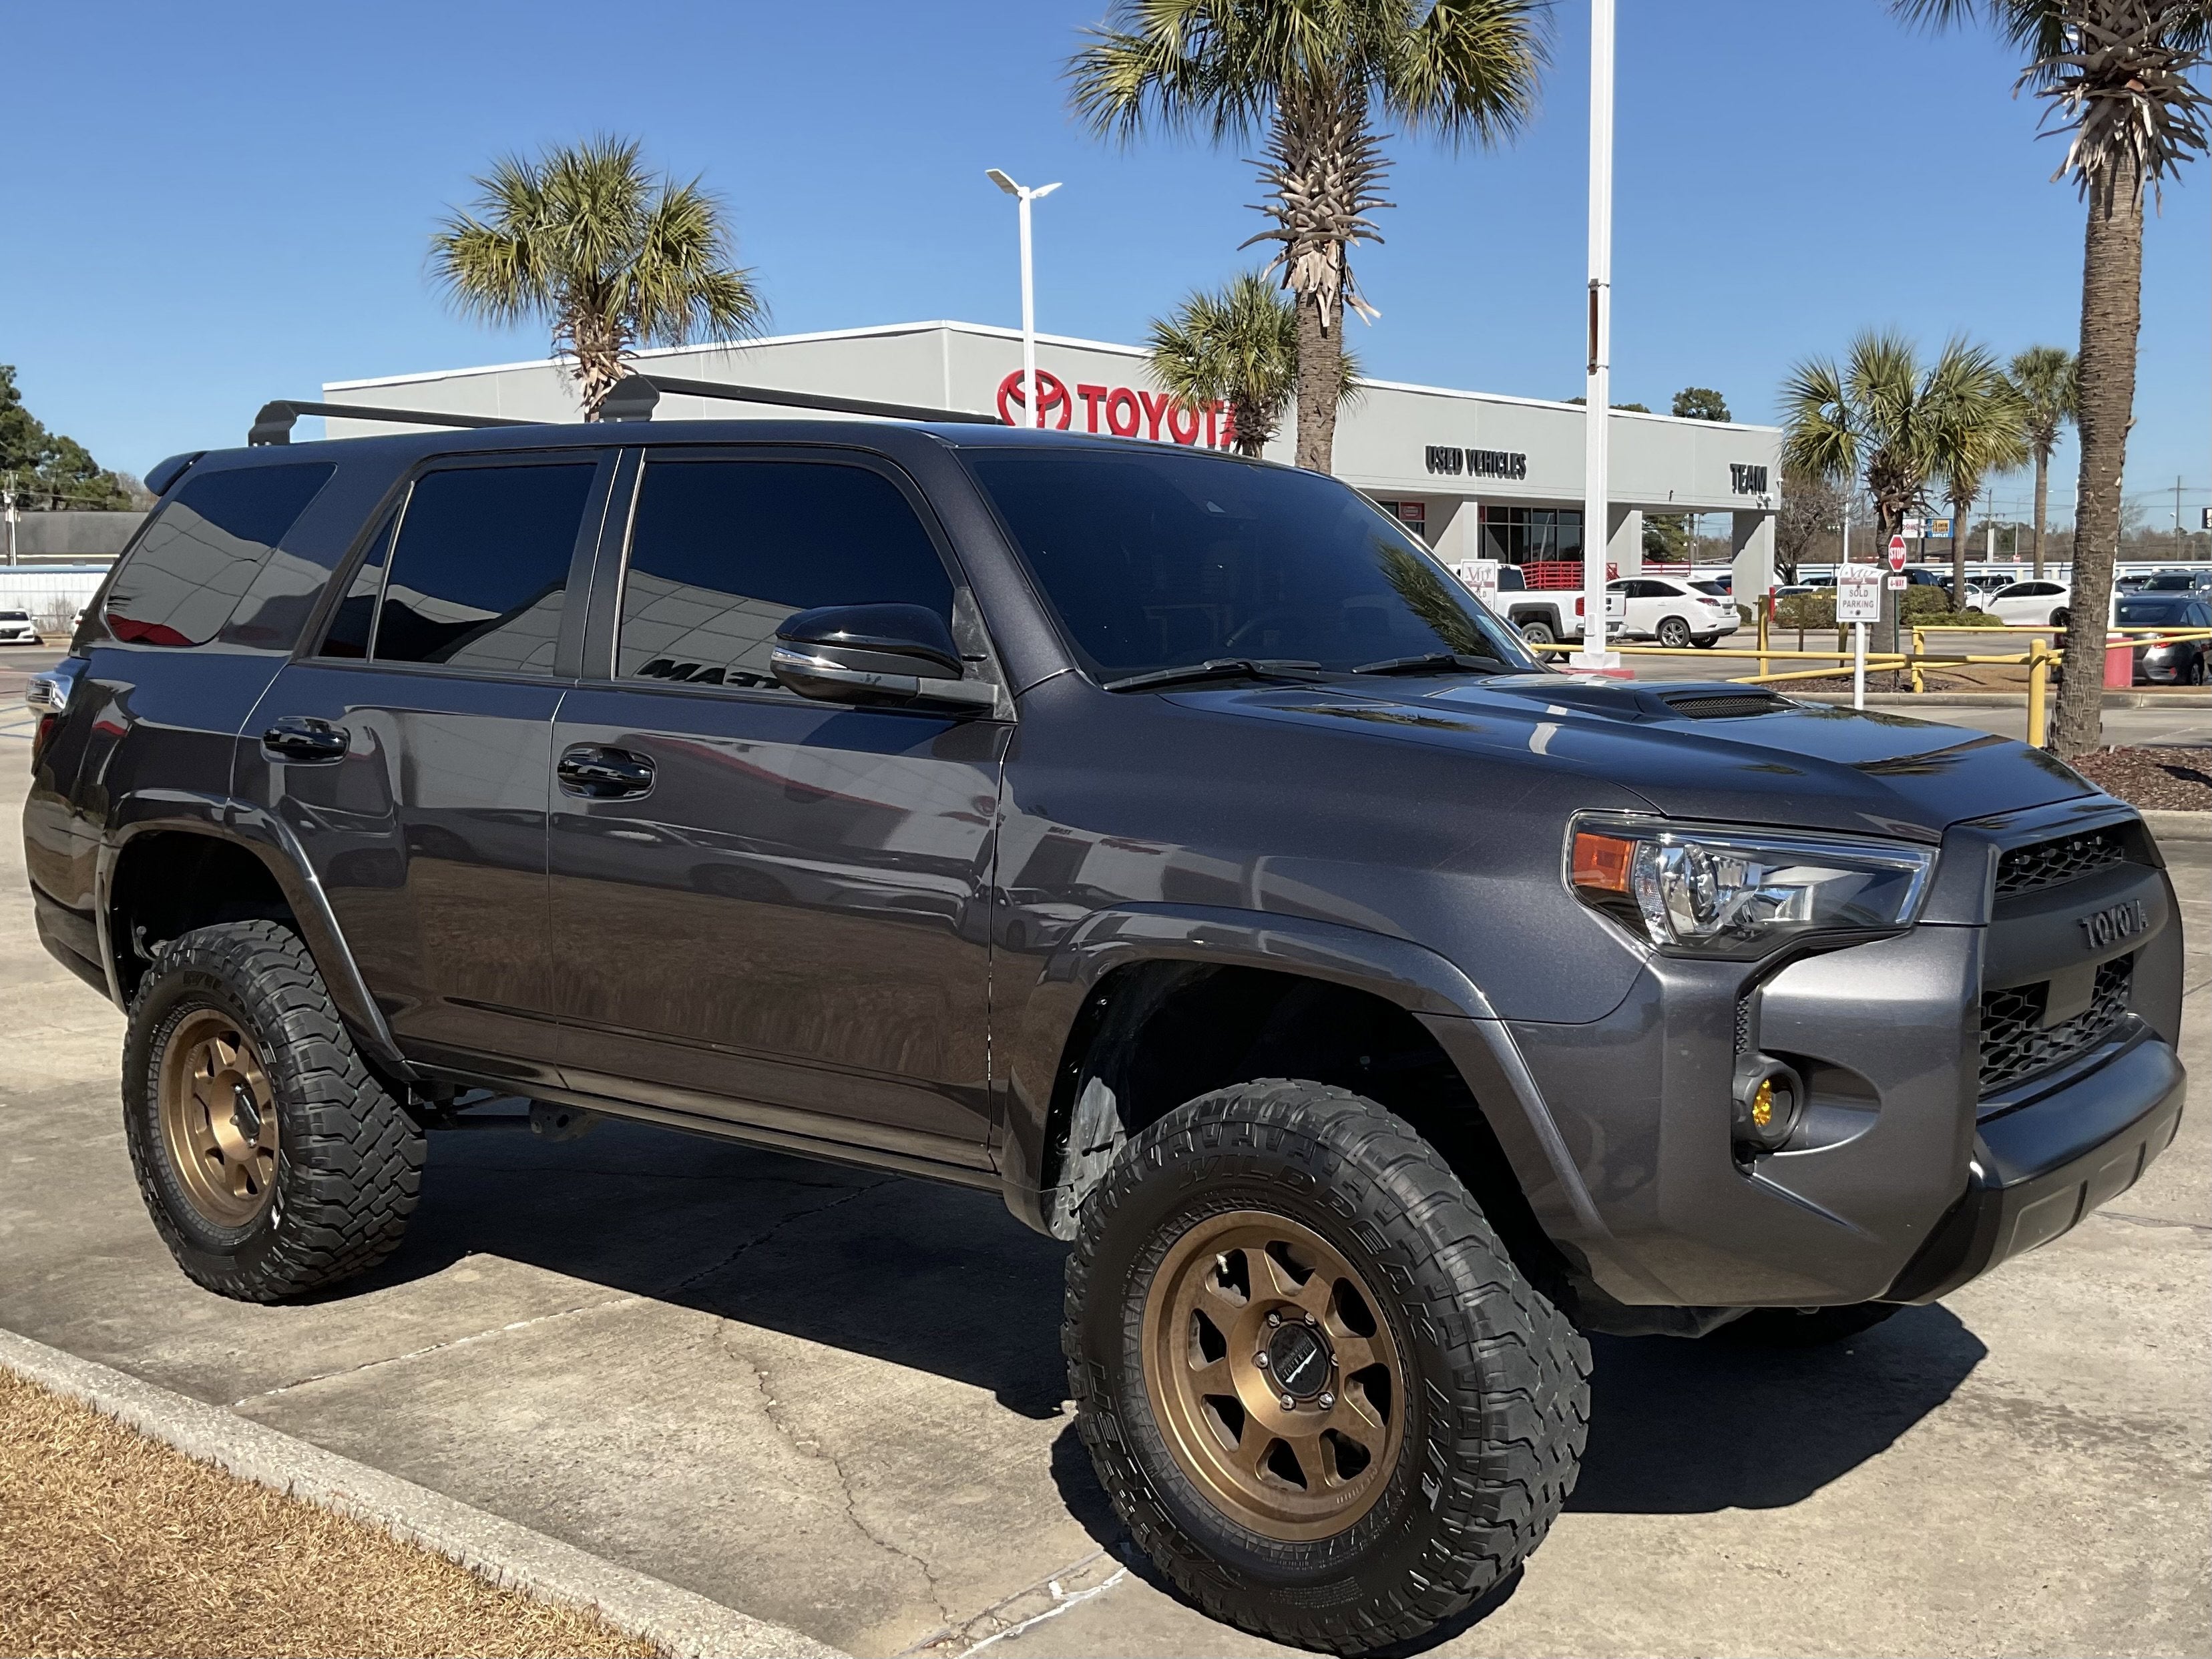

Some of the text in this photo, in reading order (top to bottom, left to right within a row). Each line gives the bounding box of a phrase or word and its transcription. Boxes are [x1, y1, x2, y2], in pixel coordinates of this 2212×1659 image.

[1425, 445, 1526, 479] USED VEHICLES
[1729, 463, 1767, 494] TEAM
[1890, 547, 1905, 560] STOP
[1890, 578, 1904, 587] 4-WAY
[1849, 589, 1868, 598] SOLD
[1842, 600, 1874, 608] PARKING
[1178, 1152, 1439, 1347] WILDPEAK
